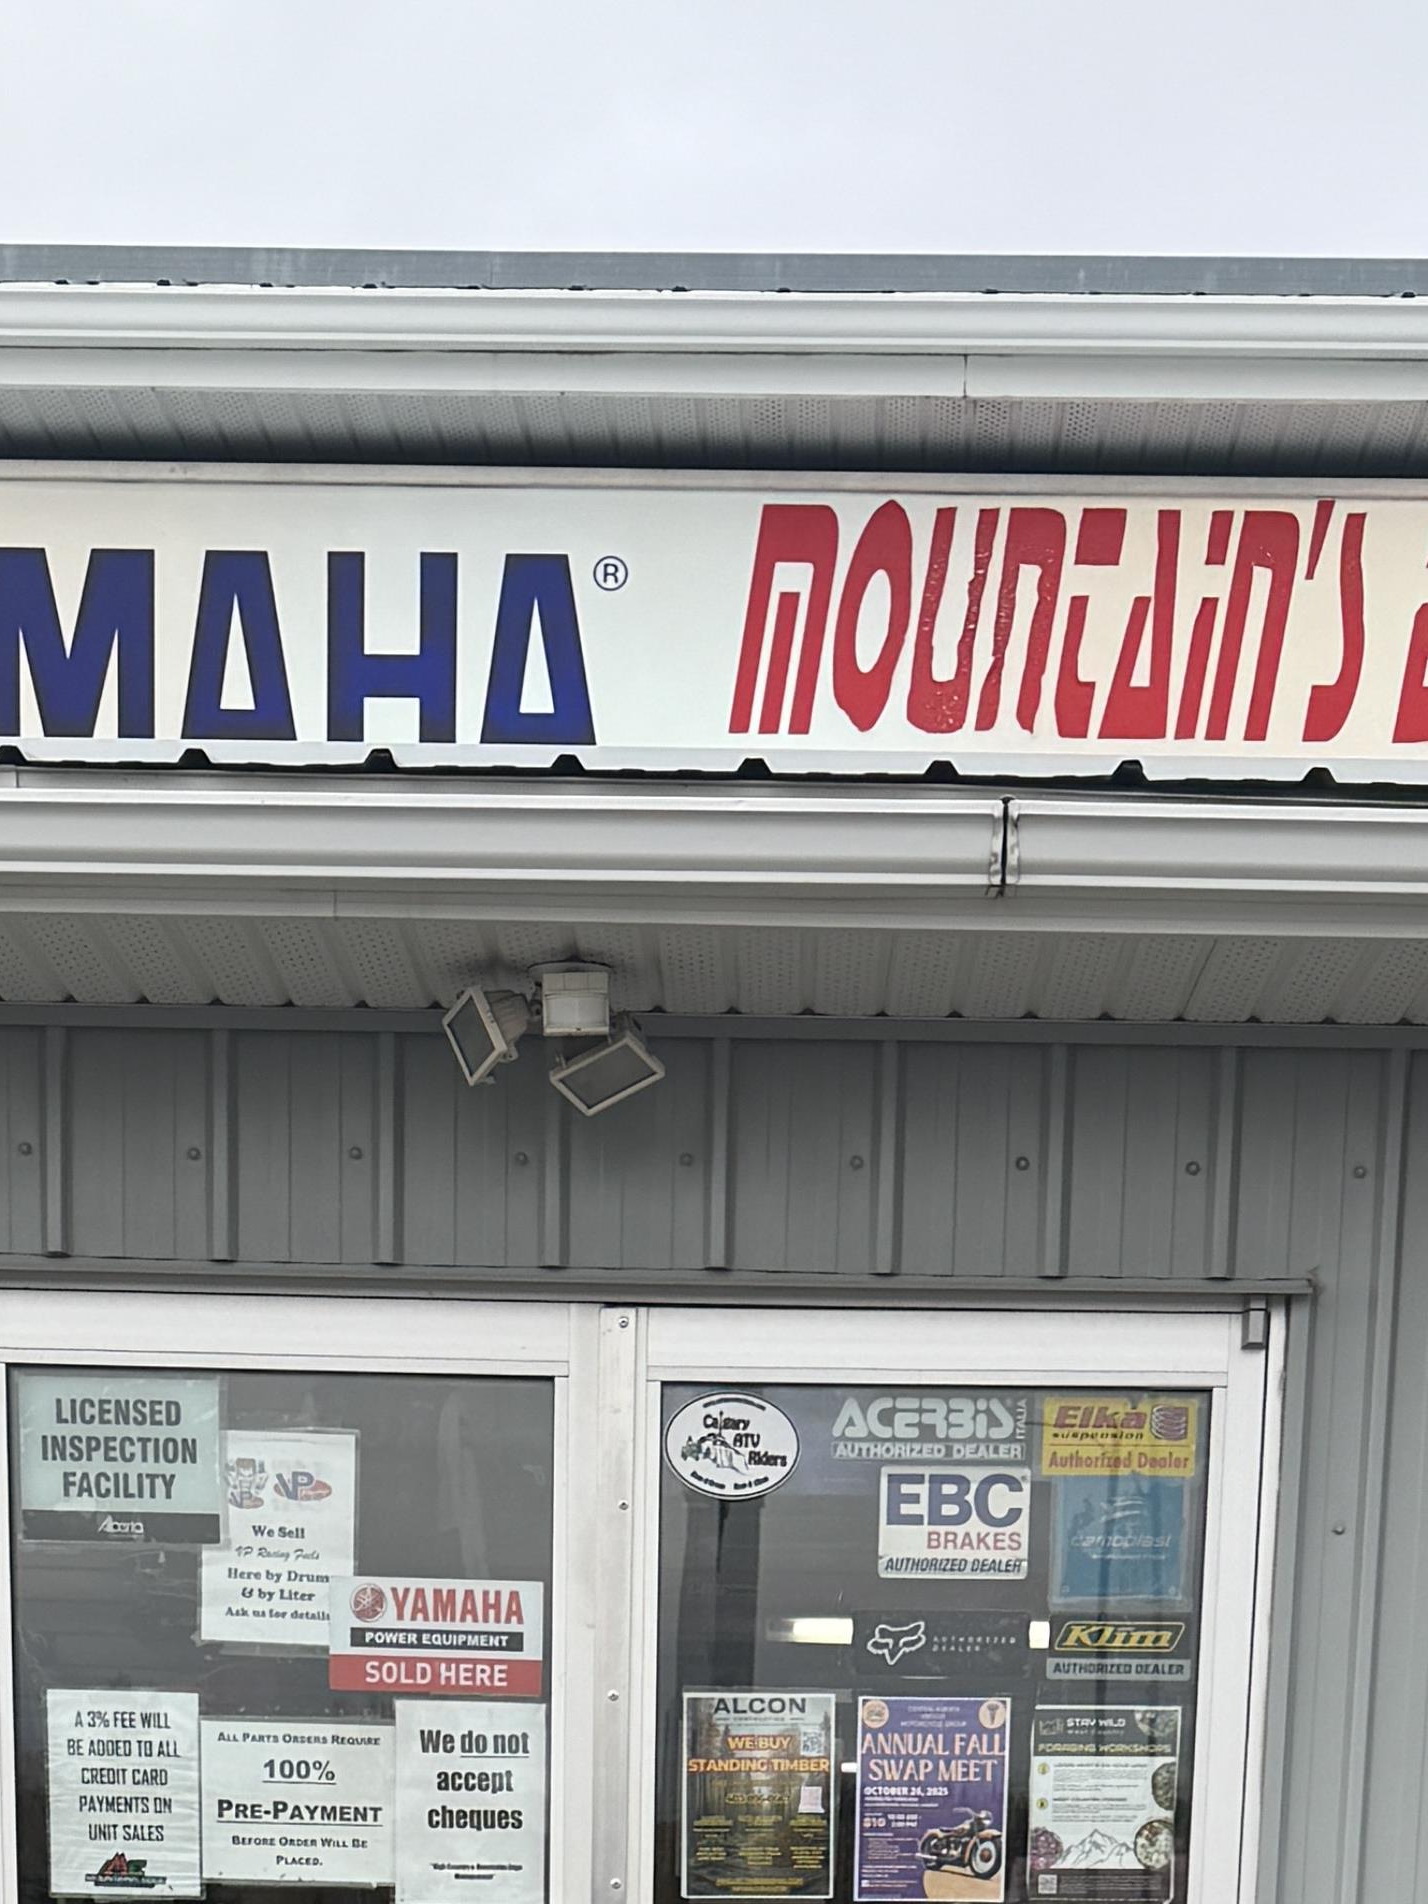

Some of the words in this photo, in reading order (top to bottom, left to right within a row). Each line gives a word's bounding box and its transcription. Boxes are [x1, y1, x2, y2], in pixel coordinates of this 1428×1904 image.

[728, 498, 1366, 742] MOUNTAIN'S
[55, 1397, 181, 1426] LICENSED
[1052, 1405, 1147, 1430] Elka
[733, 1433, 760, 1447] ATV
[1052, 1431, 1144, 1441] suspension
[41, 1435, 197, 1464] INSPECTION
[835, 1442, 946, 1459] AUTHORIZED
[953, 1443, 1022, 1460] DEALER
[1049, 1451, 1131, 1469] Authorized
[1137, 1453, 1188, 1469] Dealer
[63, 1471, 176, 1500] FACILITY
[886, 1473, 1023, 1528] EBC
[252, 1525, 275, 1538] We
[278, 1526, 305, 1539] Sell
[927, 1531, 1022, 1551] BRAKES
[227, 1567, 261, 1580] Here
[266, 1568, 282, 1583] by
[287, 1570, 329, 1583] Drum
[885, 1558, 967, 1573] AUTHORIZED
[970, 1559, 1022, 1574] DEALER
[258, 1588, 275, 1601] by
[279, 1589, 316, 1601] Liter
[225, 1606, 249, 1617] Ask
[252, 1609, 267, 1618] us
[269, 1608, 287, 1619] for
[390, 1587, 524, 1625] YAMAHA
[365, 1631, 418, 1645] POWER
[423, 1632, 508, 1648] EQUIPMENT
[365, 1661, 431, 1685] SOLD
[439, 1663, 508, 1687] HERE
[1053, 1662, 1131, 1675] AUTHORIZED
[1135, 1663, 1184, 1676] DEALER
[714, 1698, 807, 1714] ALCON
[74, 1711, 83, 1728] A
[87, 1711, 110, 1728] 3%
[113, 1711, 136, 1729] FEE
[140, 1712, 171, 1729] WILL
[1098, 1719, 1126, 1727] WILD
[67, 1738, 84, 1756] BE
[88, 1739, 132, 1757] ADDED
[136, 1739, 153, 1757] TO
[157, 1740, 181, 1758] ALL
[420, 1729, 455, 1754] We
[461, 1729, 489, 1754] do
[493, 1731, 530, 1754] not
[727, 1737, 755, 1749] WE
[758, 1737, 791, 1749] BUY
[861, 1733, 949, 1755] ANNUAL
[954, 1734, 1005, 1756] FALL
[263, 1759, 336, 1782] 100%
[688, 1759, 768, 1772] STANDING
[771, 1759, 829, 1772] TIMBER
[868, 1759, 933, 1781] SWAP
[938, 1760, 998, 1782] MEET
[81, 1767, 127, 1785] CREDIT
[132, 1768, 168, 1786] CARD
[436, 1770, 514, 1793] accept
[864, 1786, 908, 1795] OCTOBER
[79, 1796, 149, 1814] PAYMENTS
[154, 1797, 172, 1814] ON
[216, 1798, 382, 1823] PRE-PAYMENT
[427, 1806, 523, 1831] cheques
[88, 1824, 118, 1841] UNIT
[122, 1825, 164, 1842] SALES
